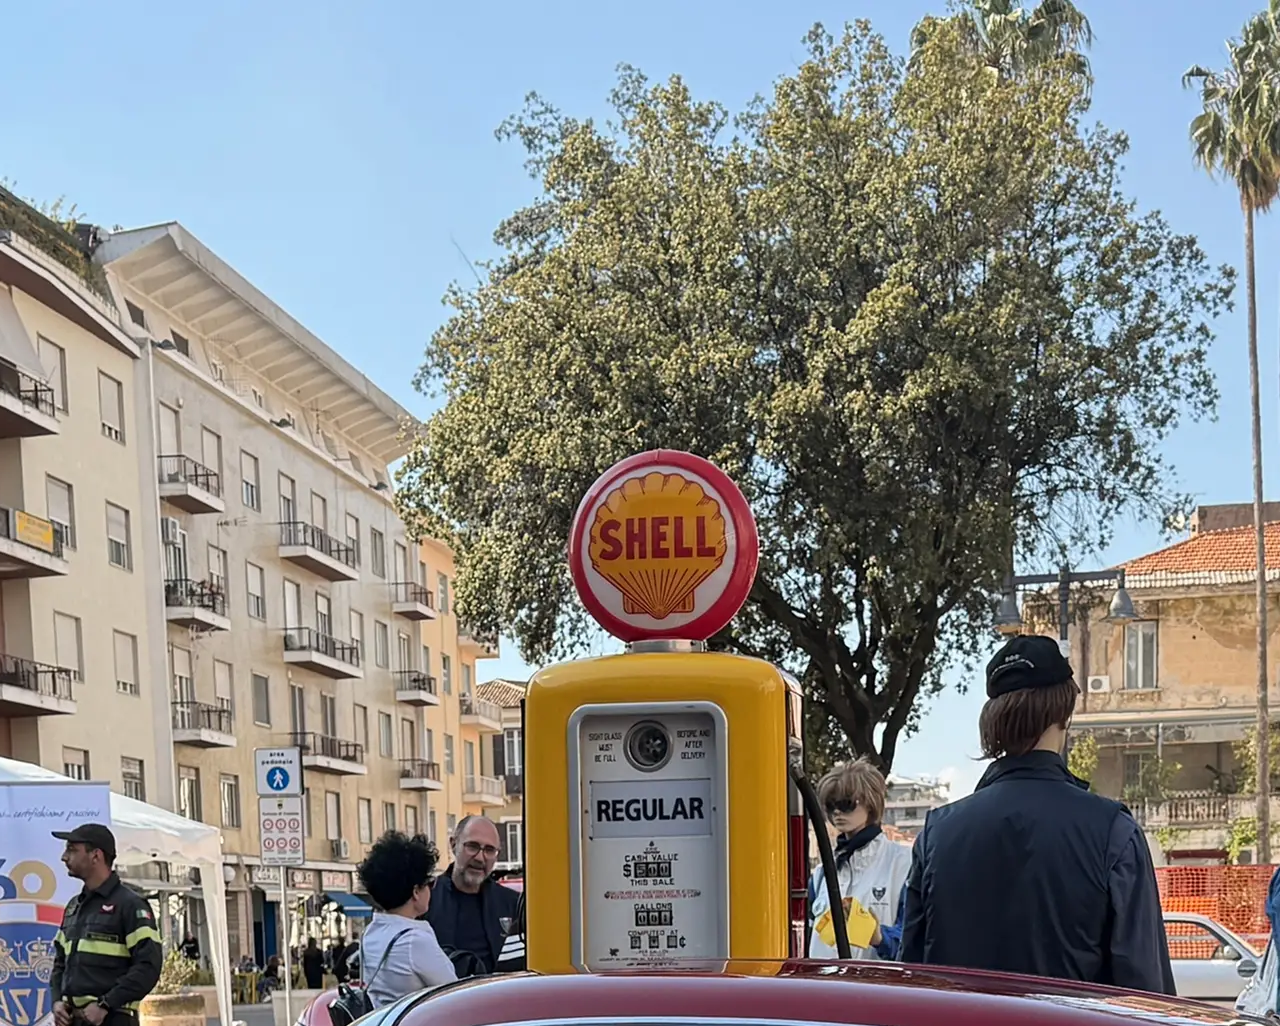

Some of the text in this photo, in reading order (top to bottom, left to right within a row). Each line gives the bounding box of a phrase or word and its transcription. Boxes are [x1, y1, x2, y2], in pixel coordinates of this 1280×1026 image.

[598, 515, 716, 561] SHELL
[684, 740, 703, 749] AFTER
[680, 751, 706, 760] DELIVERY
[596, 797, 704, 822] REGULAR
[624, 853, 679, 862] CASH VALUE
[652, 878, 675, 886] SALE
[633, 902, 673, 911] GALLONS
